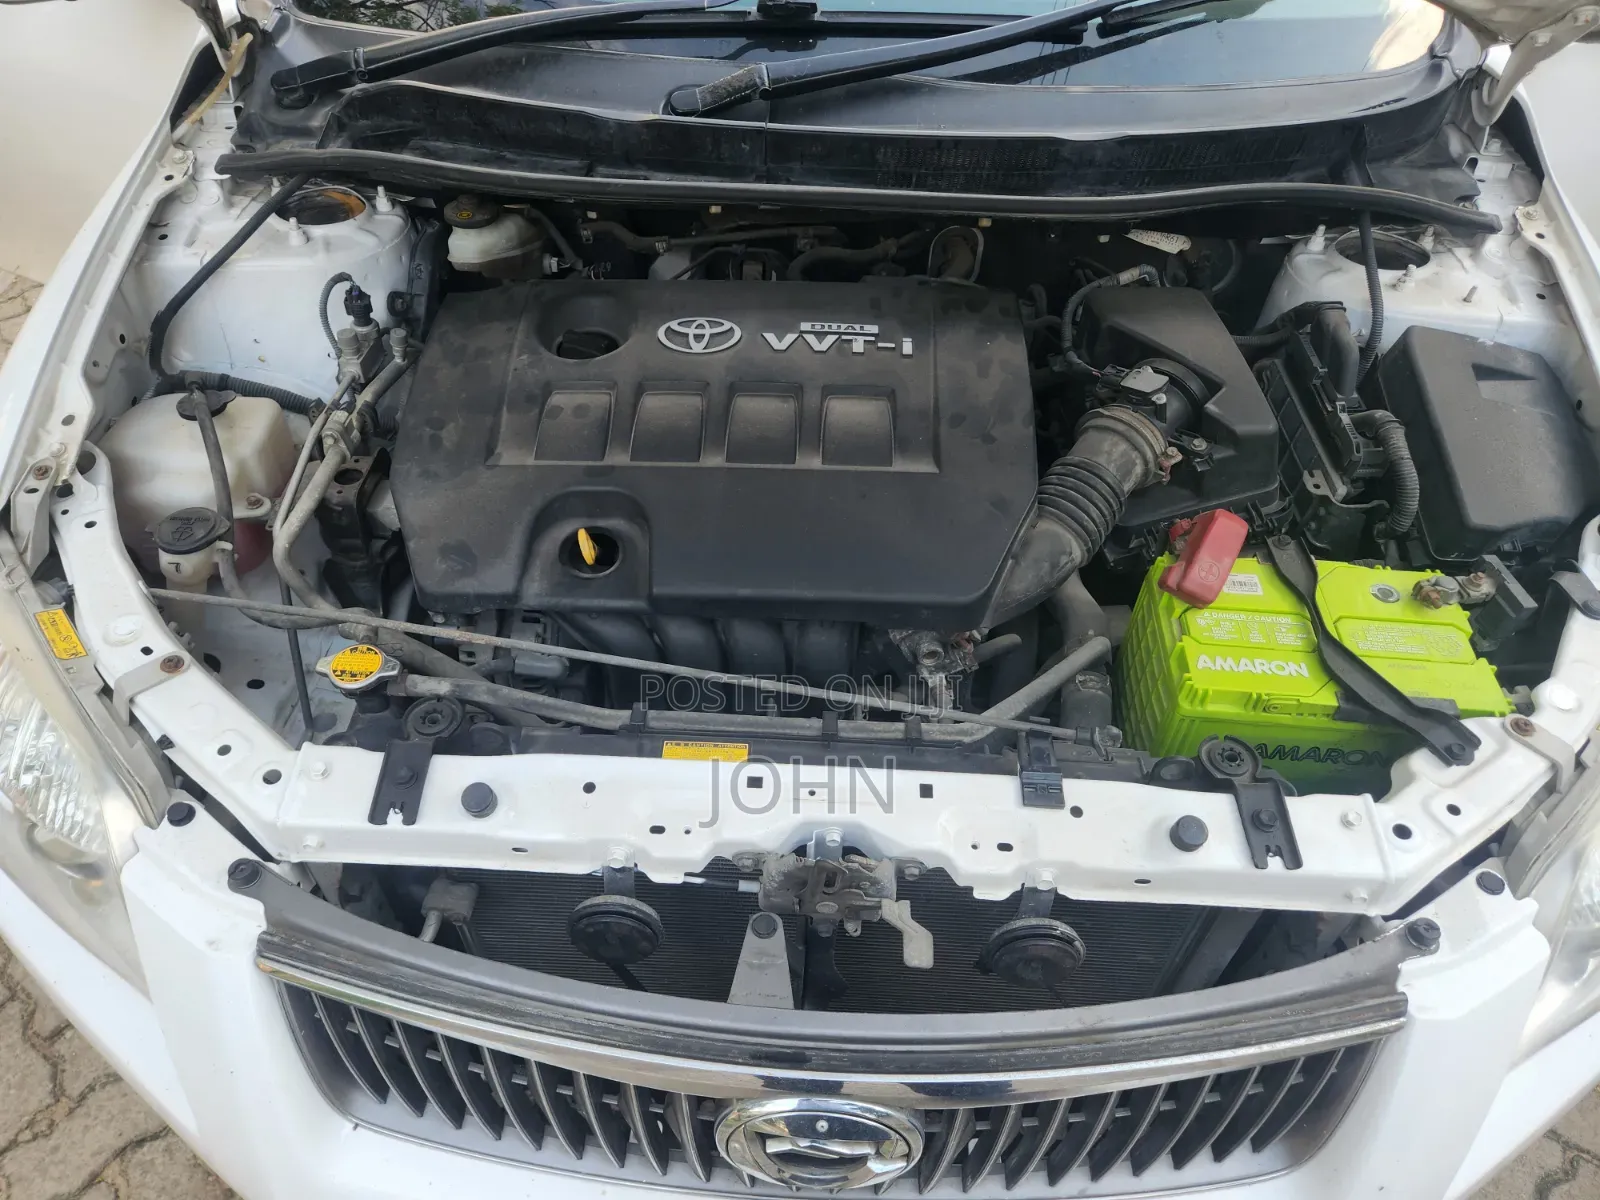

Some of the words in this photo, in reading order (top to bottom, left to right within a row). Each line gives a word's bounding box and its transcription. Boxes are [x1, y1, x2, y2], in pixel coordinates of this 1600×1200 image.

[809, 323, 873, 333] DUAL
[761, 332, 913, 357] VVT-i
[1212, 611, 1246, 621] DANGER
[1254, 615, 1291, 624] CAUTION
[1197, 654, 1309, 678] AMARON
[1254, 743, 1387, 767] AMARON
